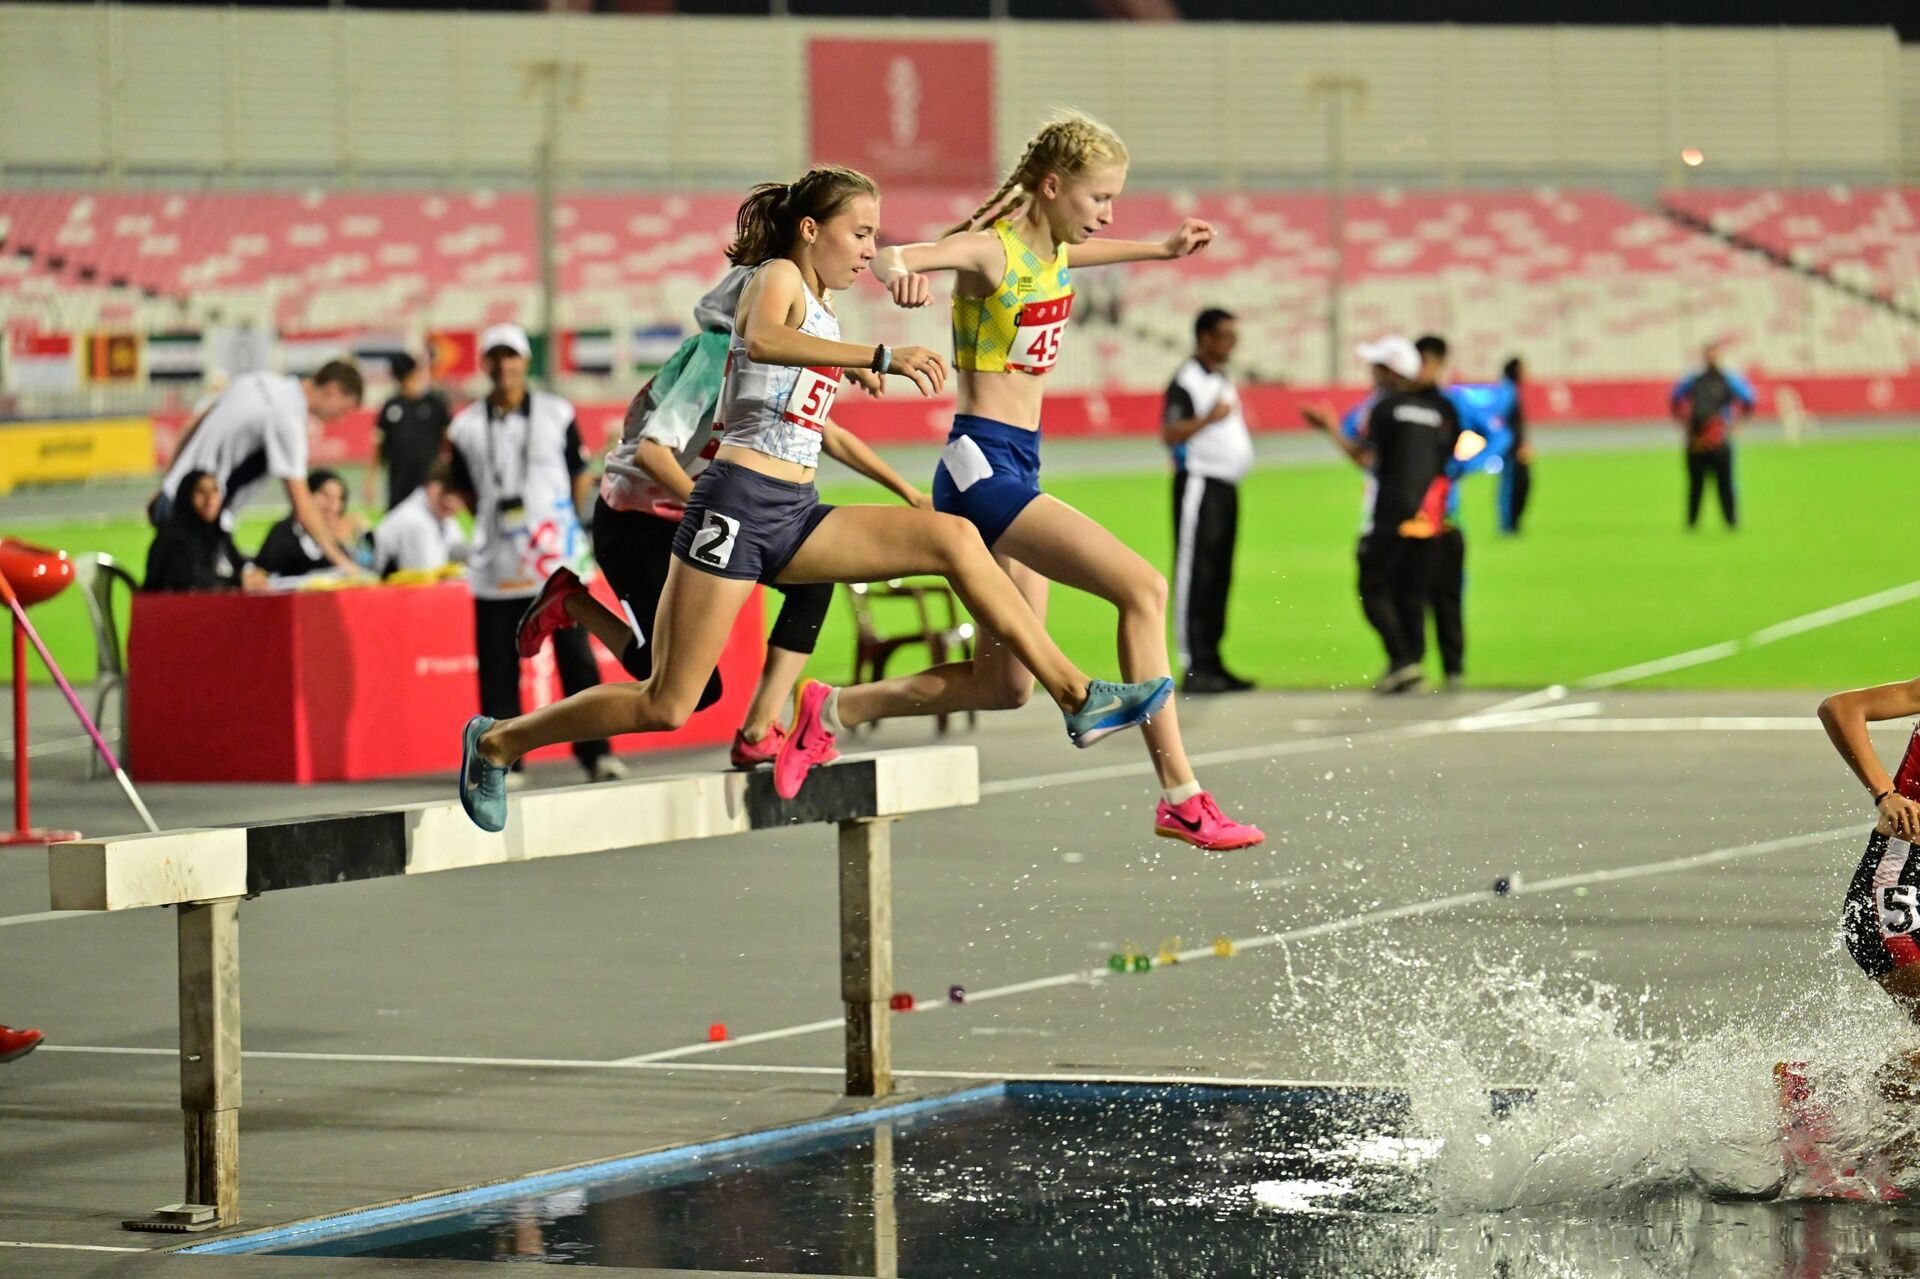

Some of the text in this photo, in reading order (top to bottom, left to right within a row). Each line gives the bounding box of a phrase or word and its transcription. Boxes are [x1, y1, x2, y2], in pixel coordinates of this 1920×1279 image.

[1027, 326, 1062, 362] 45
[801, 379, 837, 420] 57
[695, 515, 730, 565] 2
[1883, 886, 1913, 933] 5
